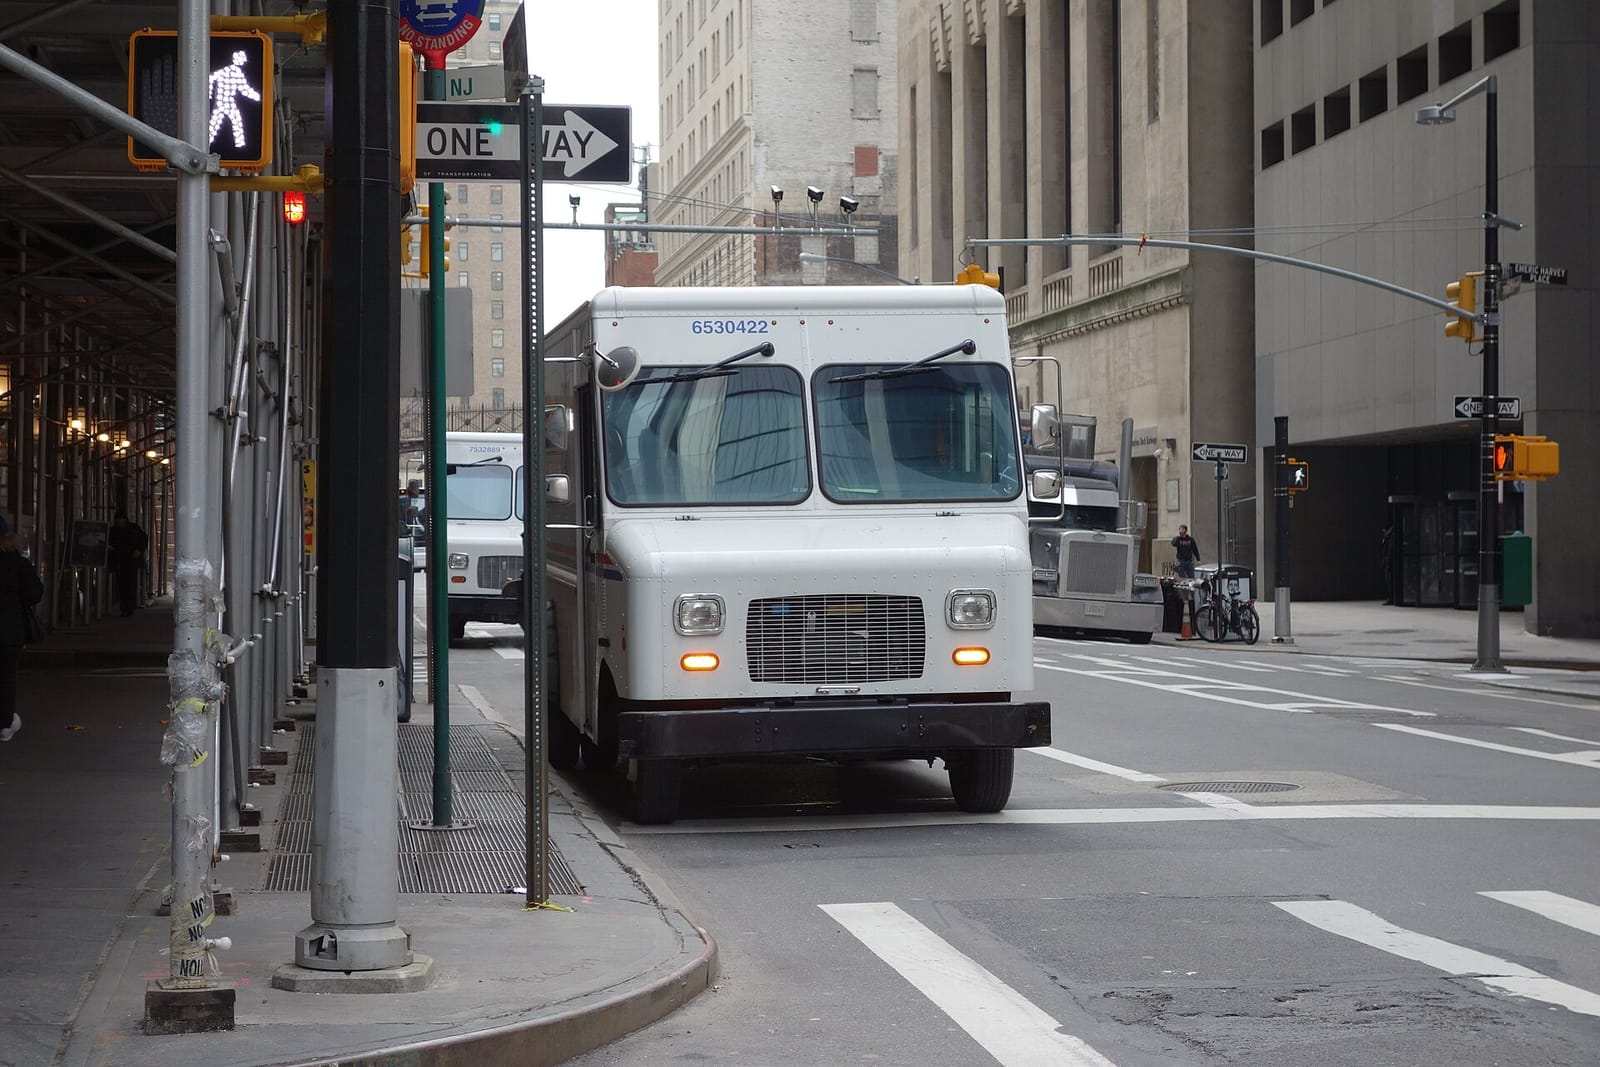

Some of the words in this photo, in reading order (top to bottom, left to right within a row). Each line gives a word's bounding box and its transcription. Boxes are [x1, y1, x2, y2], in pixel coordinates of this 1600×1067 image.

[399, 23, 415, 41] NO
[416, 19, 474, 50] STANDING
[450, 78, 473, 97] NJ
[427, 127, 494, 157] ONE
[1529, 273, 1551, 285] PLACE
[691, 320, 769, 334] 6530422
[1200, 448, 1217, 457] ONE
[1224, 449, 1242, 458] WAY
